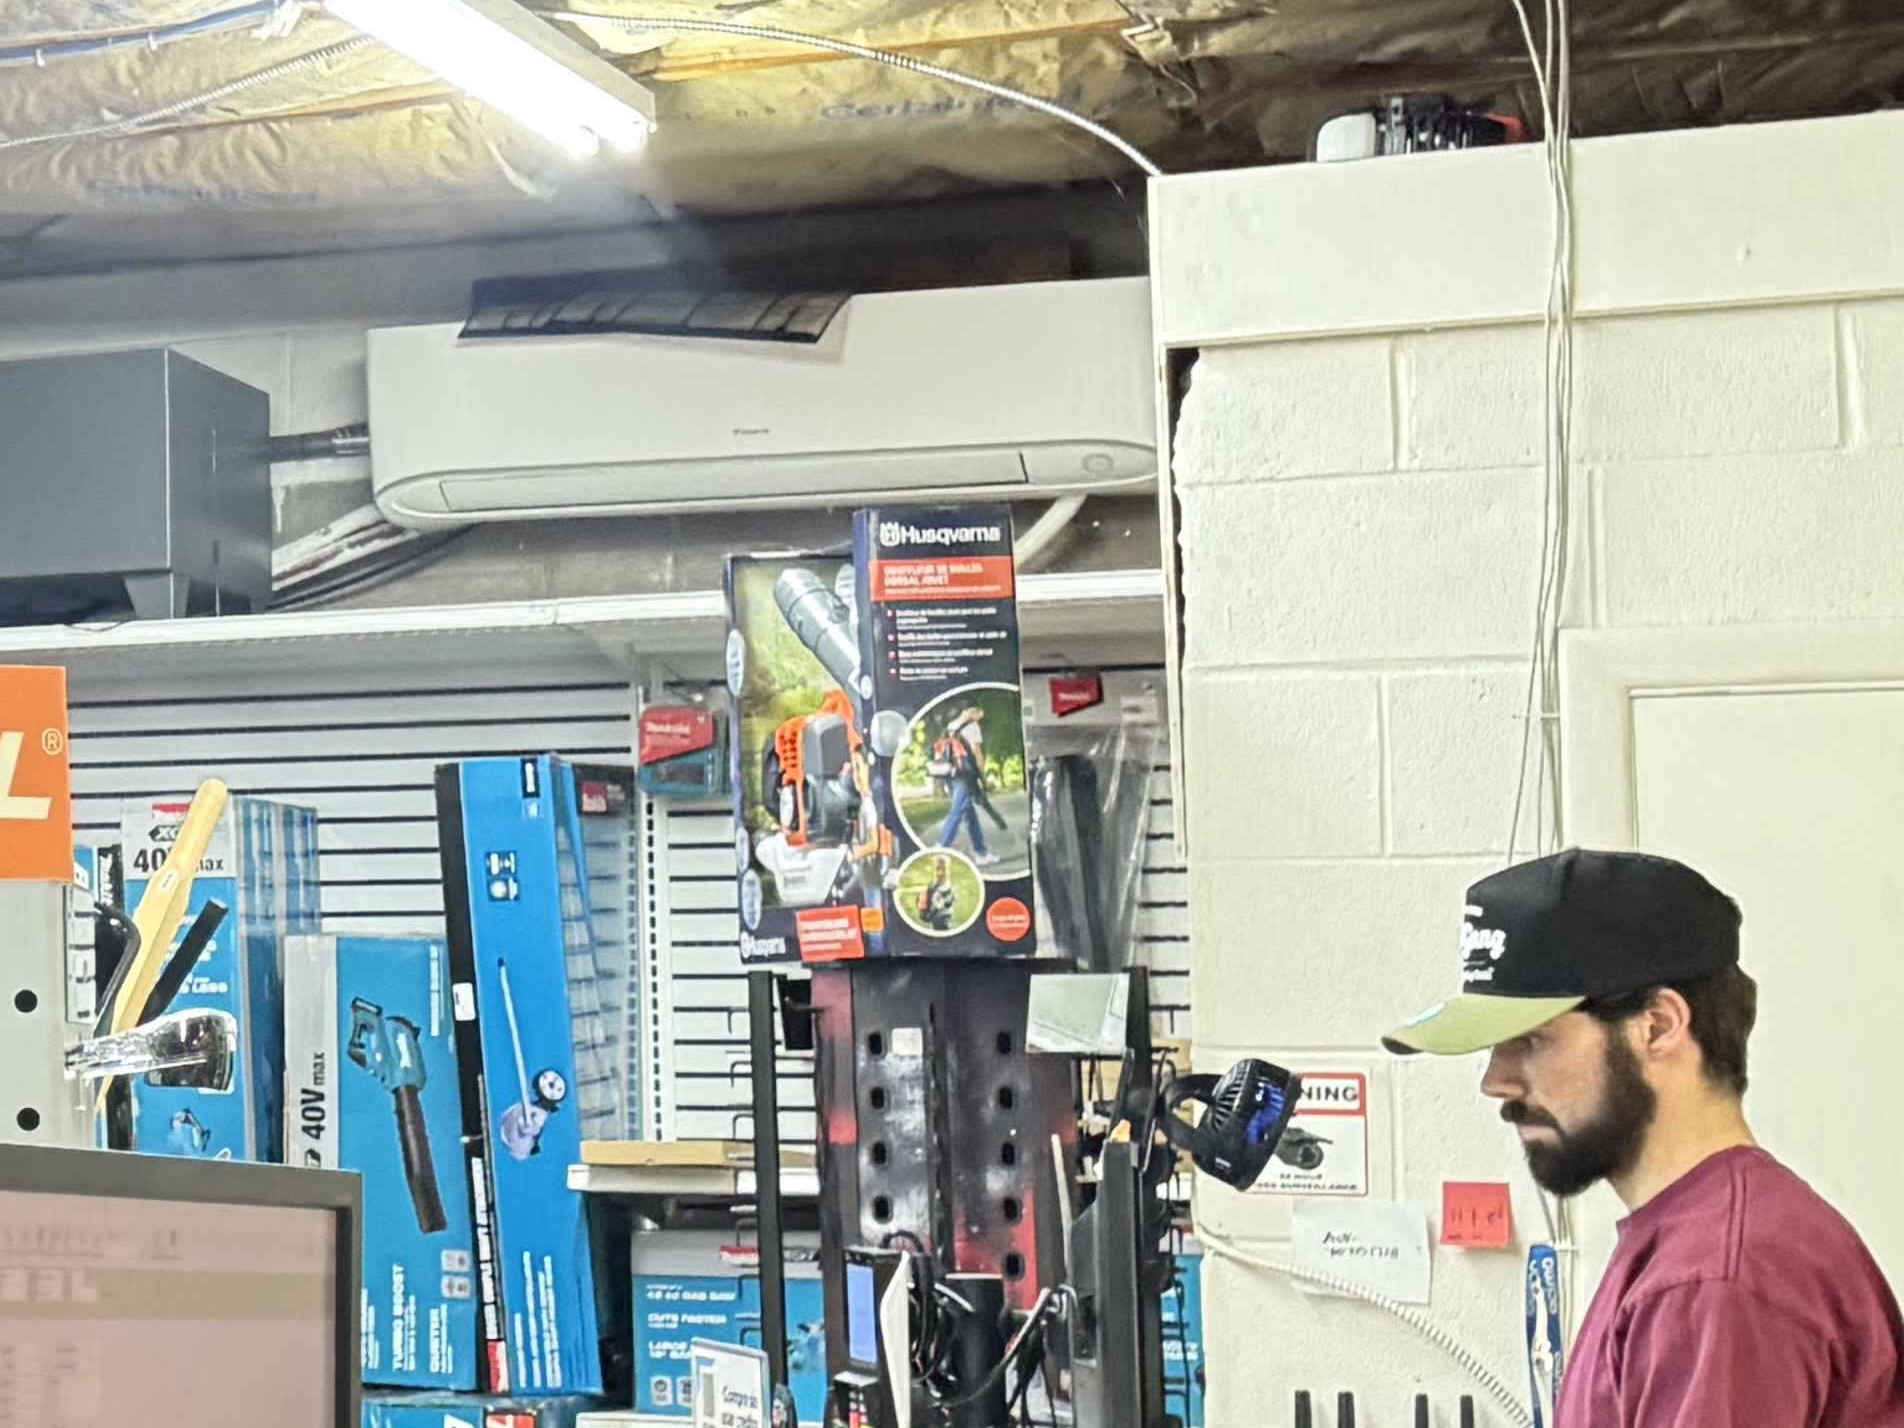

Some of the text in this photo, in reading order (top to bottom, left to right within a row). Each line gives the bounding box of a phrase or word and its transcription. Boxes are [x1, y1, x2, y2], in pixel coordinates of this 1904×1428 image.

[900, 524, 1001, 546] Husqvarna
[301, 1051, 327, 1141] 40V max
[1299, 1086, 1360, 1102] NING
